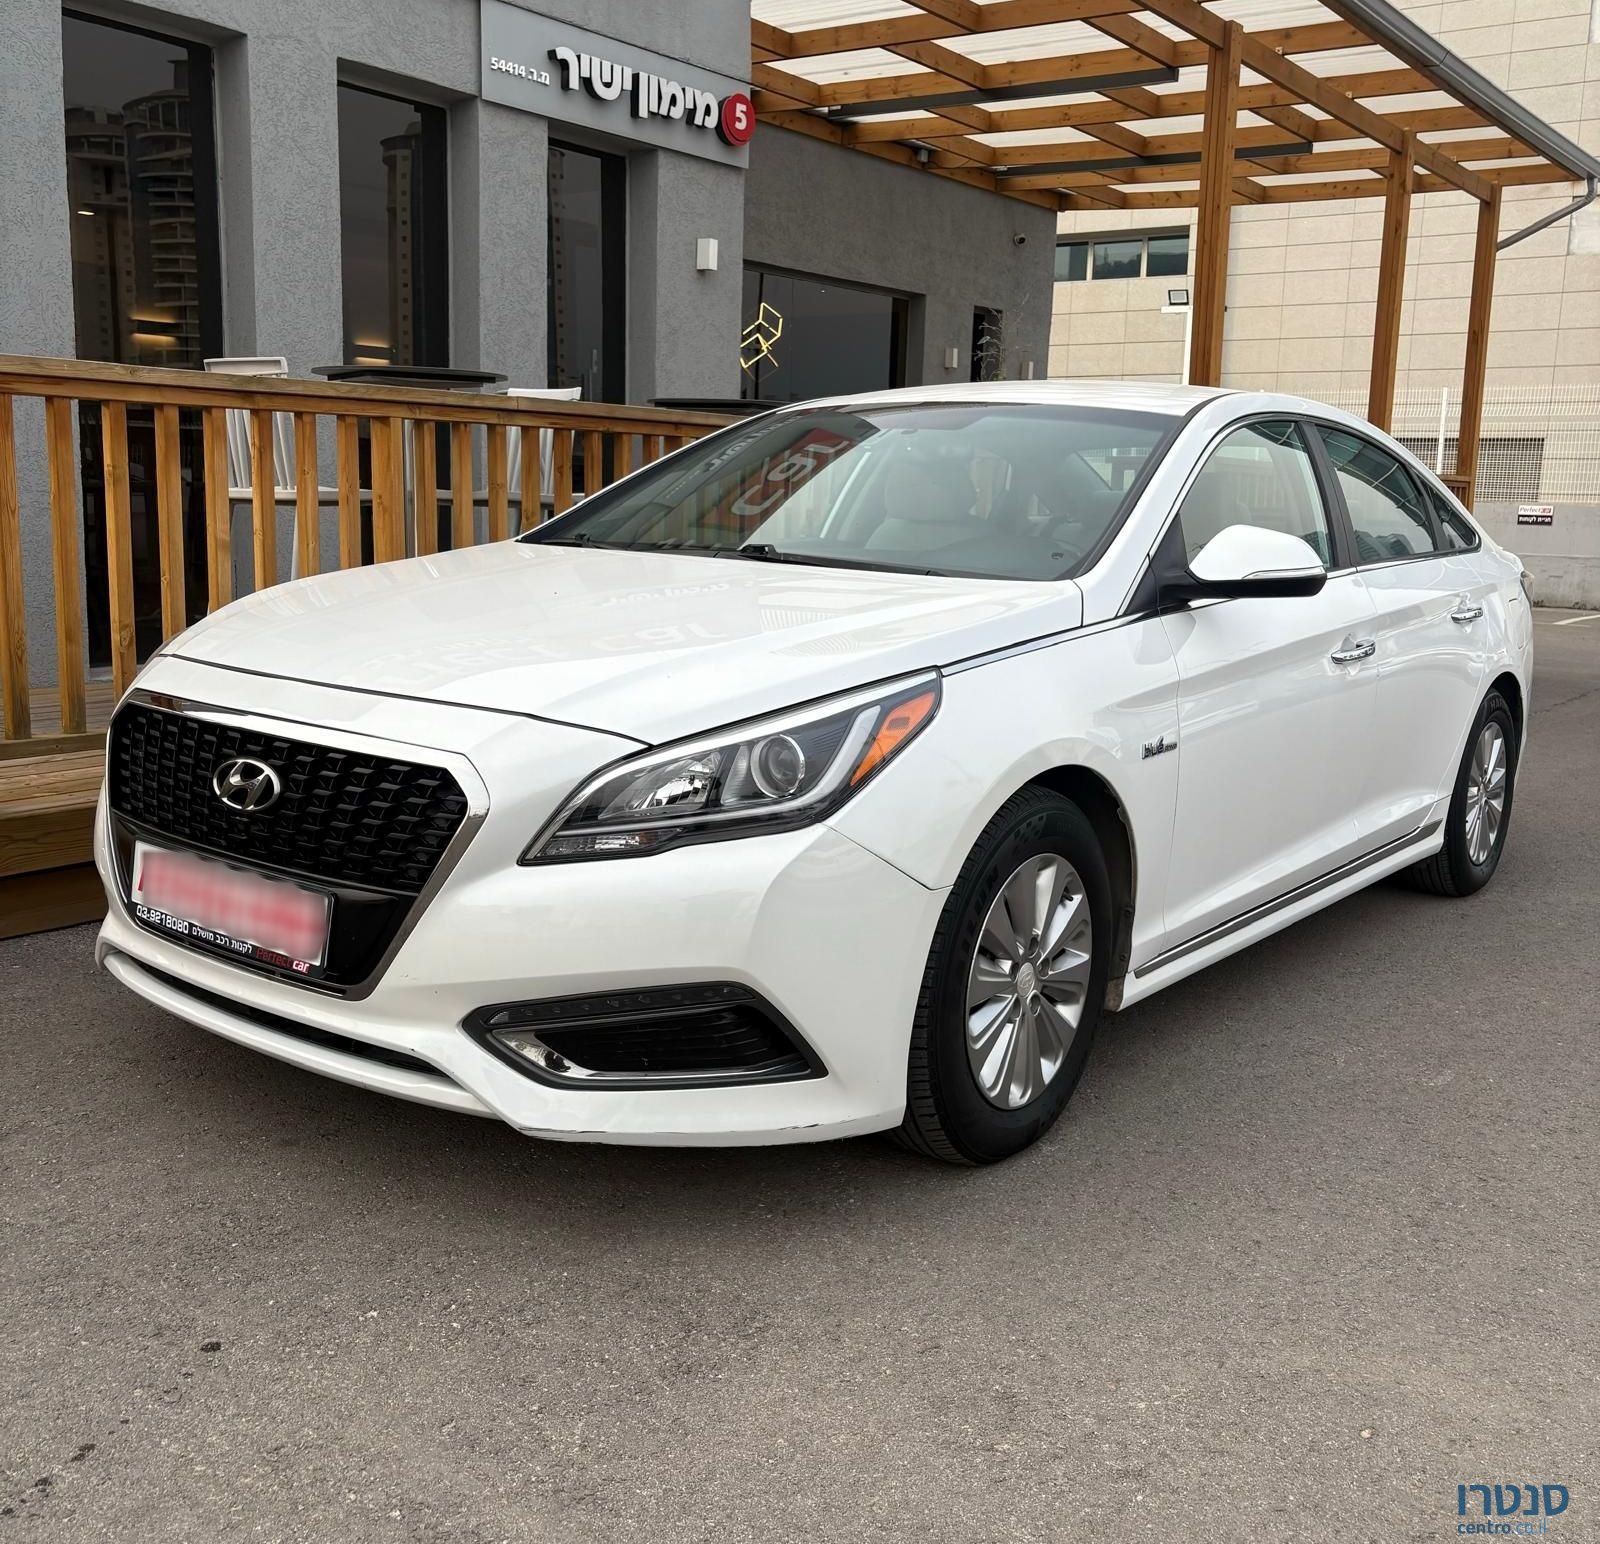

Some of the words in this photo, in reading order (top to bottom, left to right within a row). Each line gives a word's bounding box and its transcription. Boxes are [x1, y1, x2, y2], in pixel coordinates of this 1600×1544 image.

[490, 56, 526, 78] 54414
[550, 46, 633, 101] ישיר
[632, 71, 719, 129] מימון
[136, 904, 189, 934] 03-9218080
[192, 926, 215, 941] מושלם
[215, 933, 230, 947] רכב
[231, 939, 253, 954] לקנות
[292, 960, 310, 974] car
